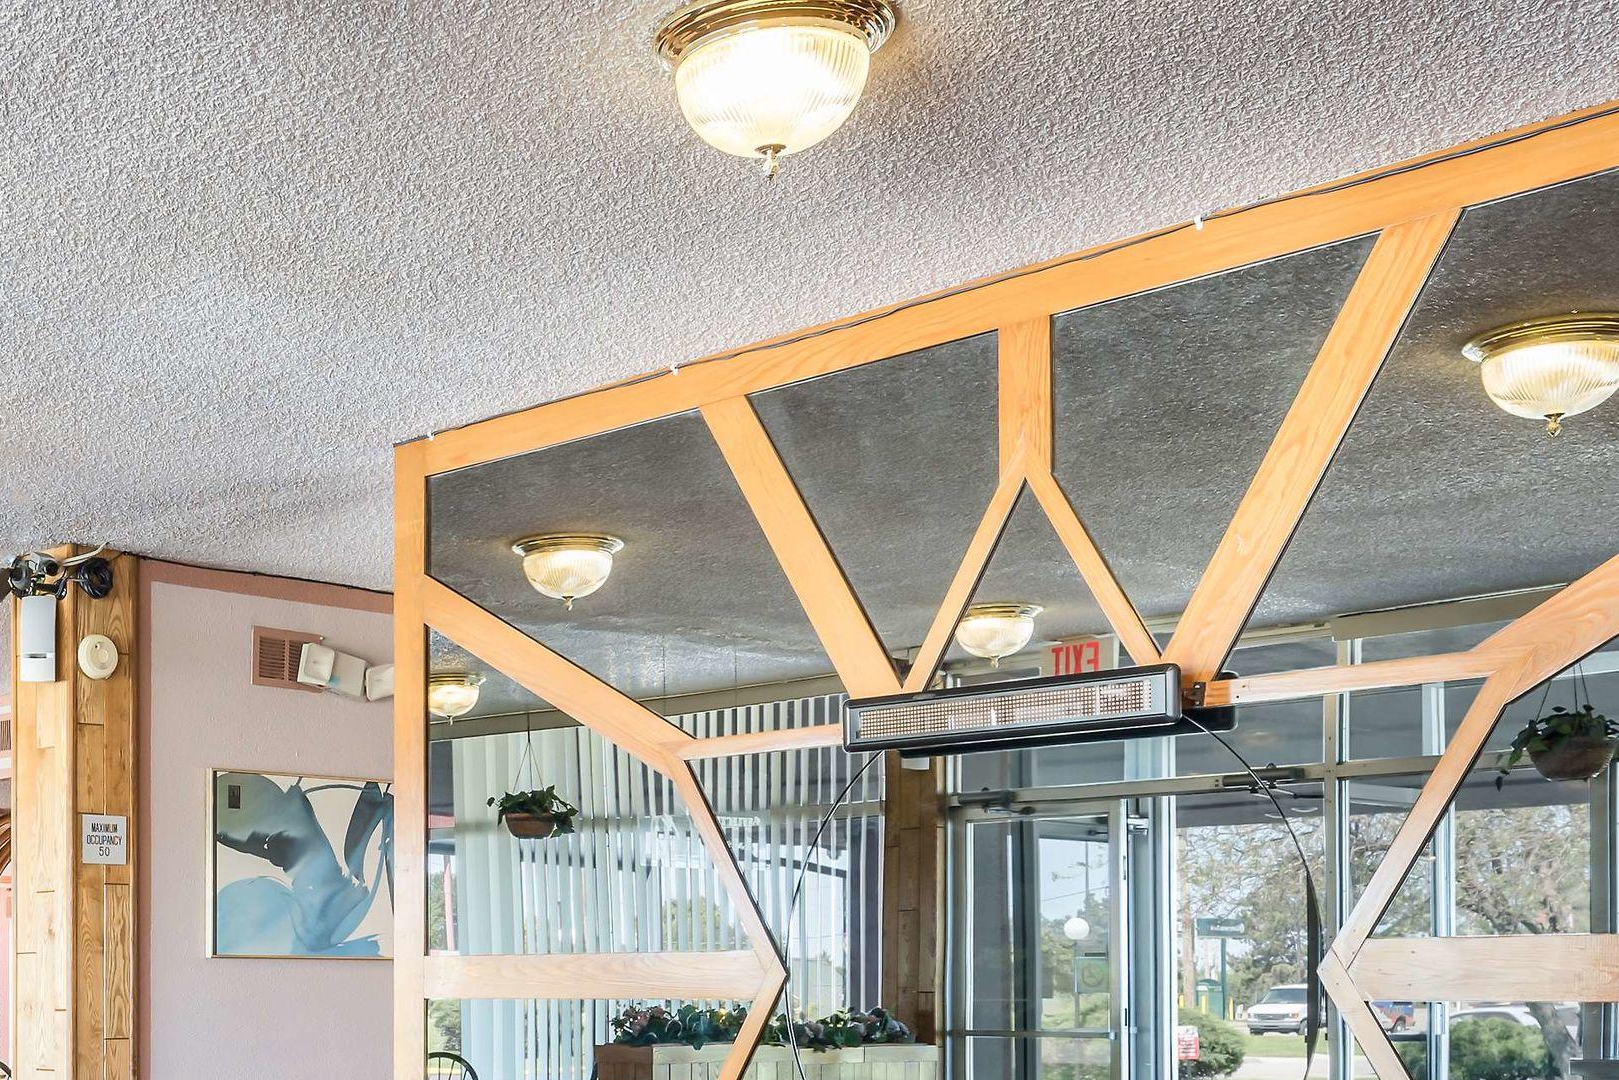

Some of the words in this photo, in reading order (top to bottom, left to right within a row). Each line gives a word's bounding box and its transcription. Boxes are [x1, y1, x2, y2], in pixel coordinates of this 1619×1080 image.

[91, 823, 118, 833] MAXIMUM
[86, 834, 122, 845] OCCUPANCY
[98, 846, 111, 856] 50
